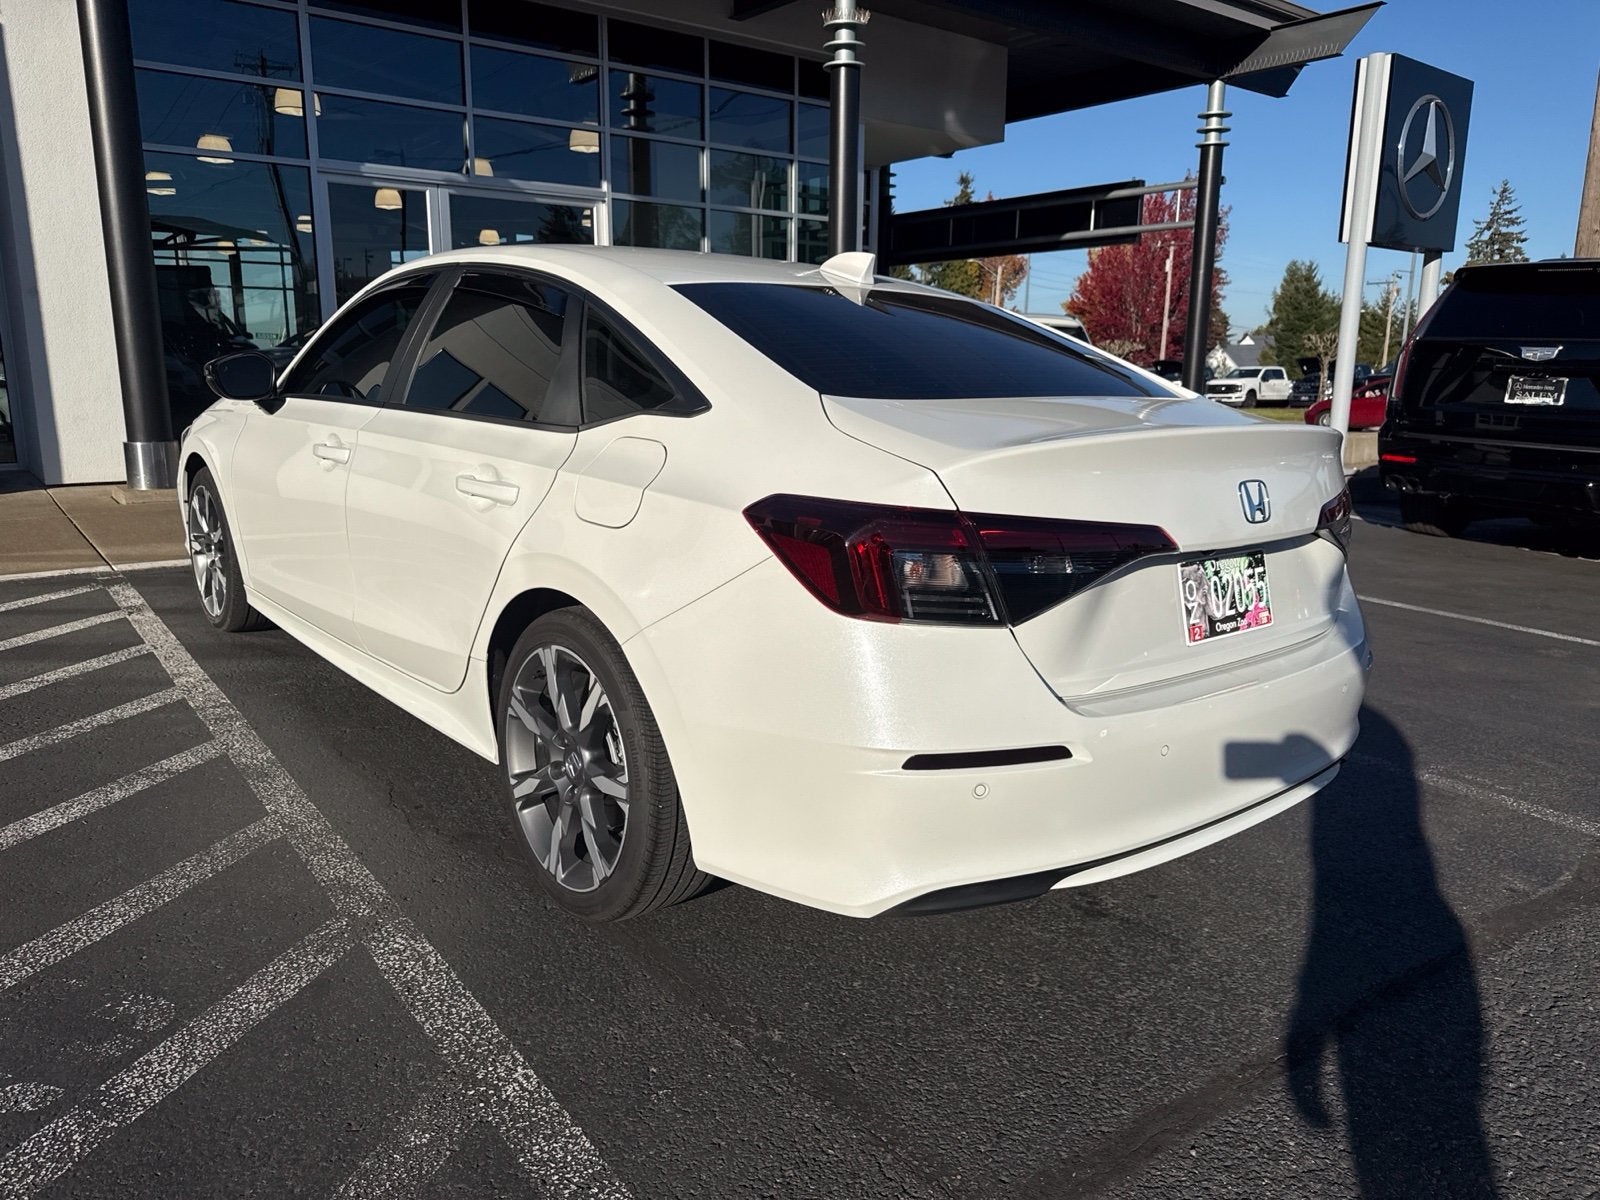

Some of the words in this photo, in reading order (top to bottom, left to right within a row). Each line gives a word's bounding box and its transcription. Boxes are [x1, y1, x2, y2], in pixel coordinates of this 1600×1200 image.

[1515, 390, 1559, 400] SALEM
[1210, 566, 1267, 618] 02055
[1215, 620, 1237, 632] Oregon
[1236, 617, 1248, 626] Zoo
